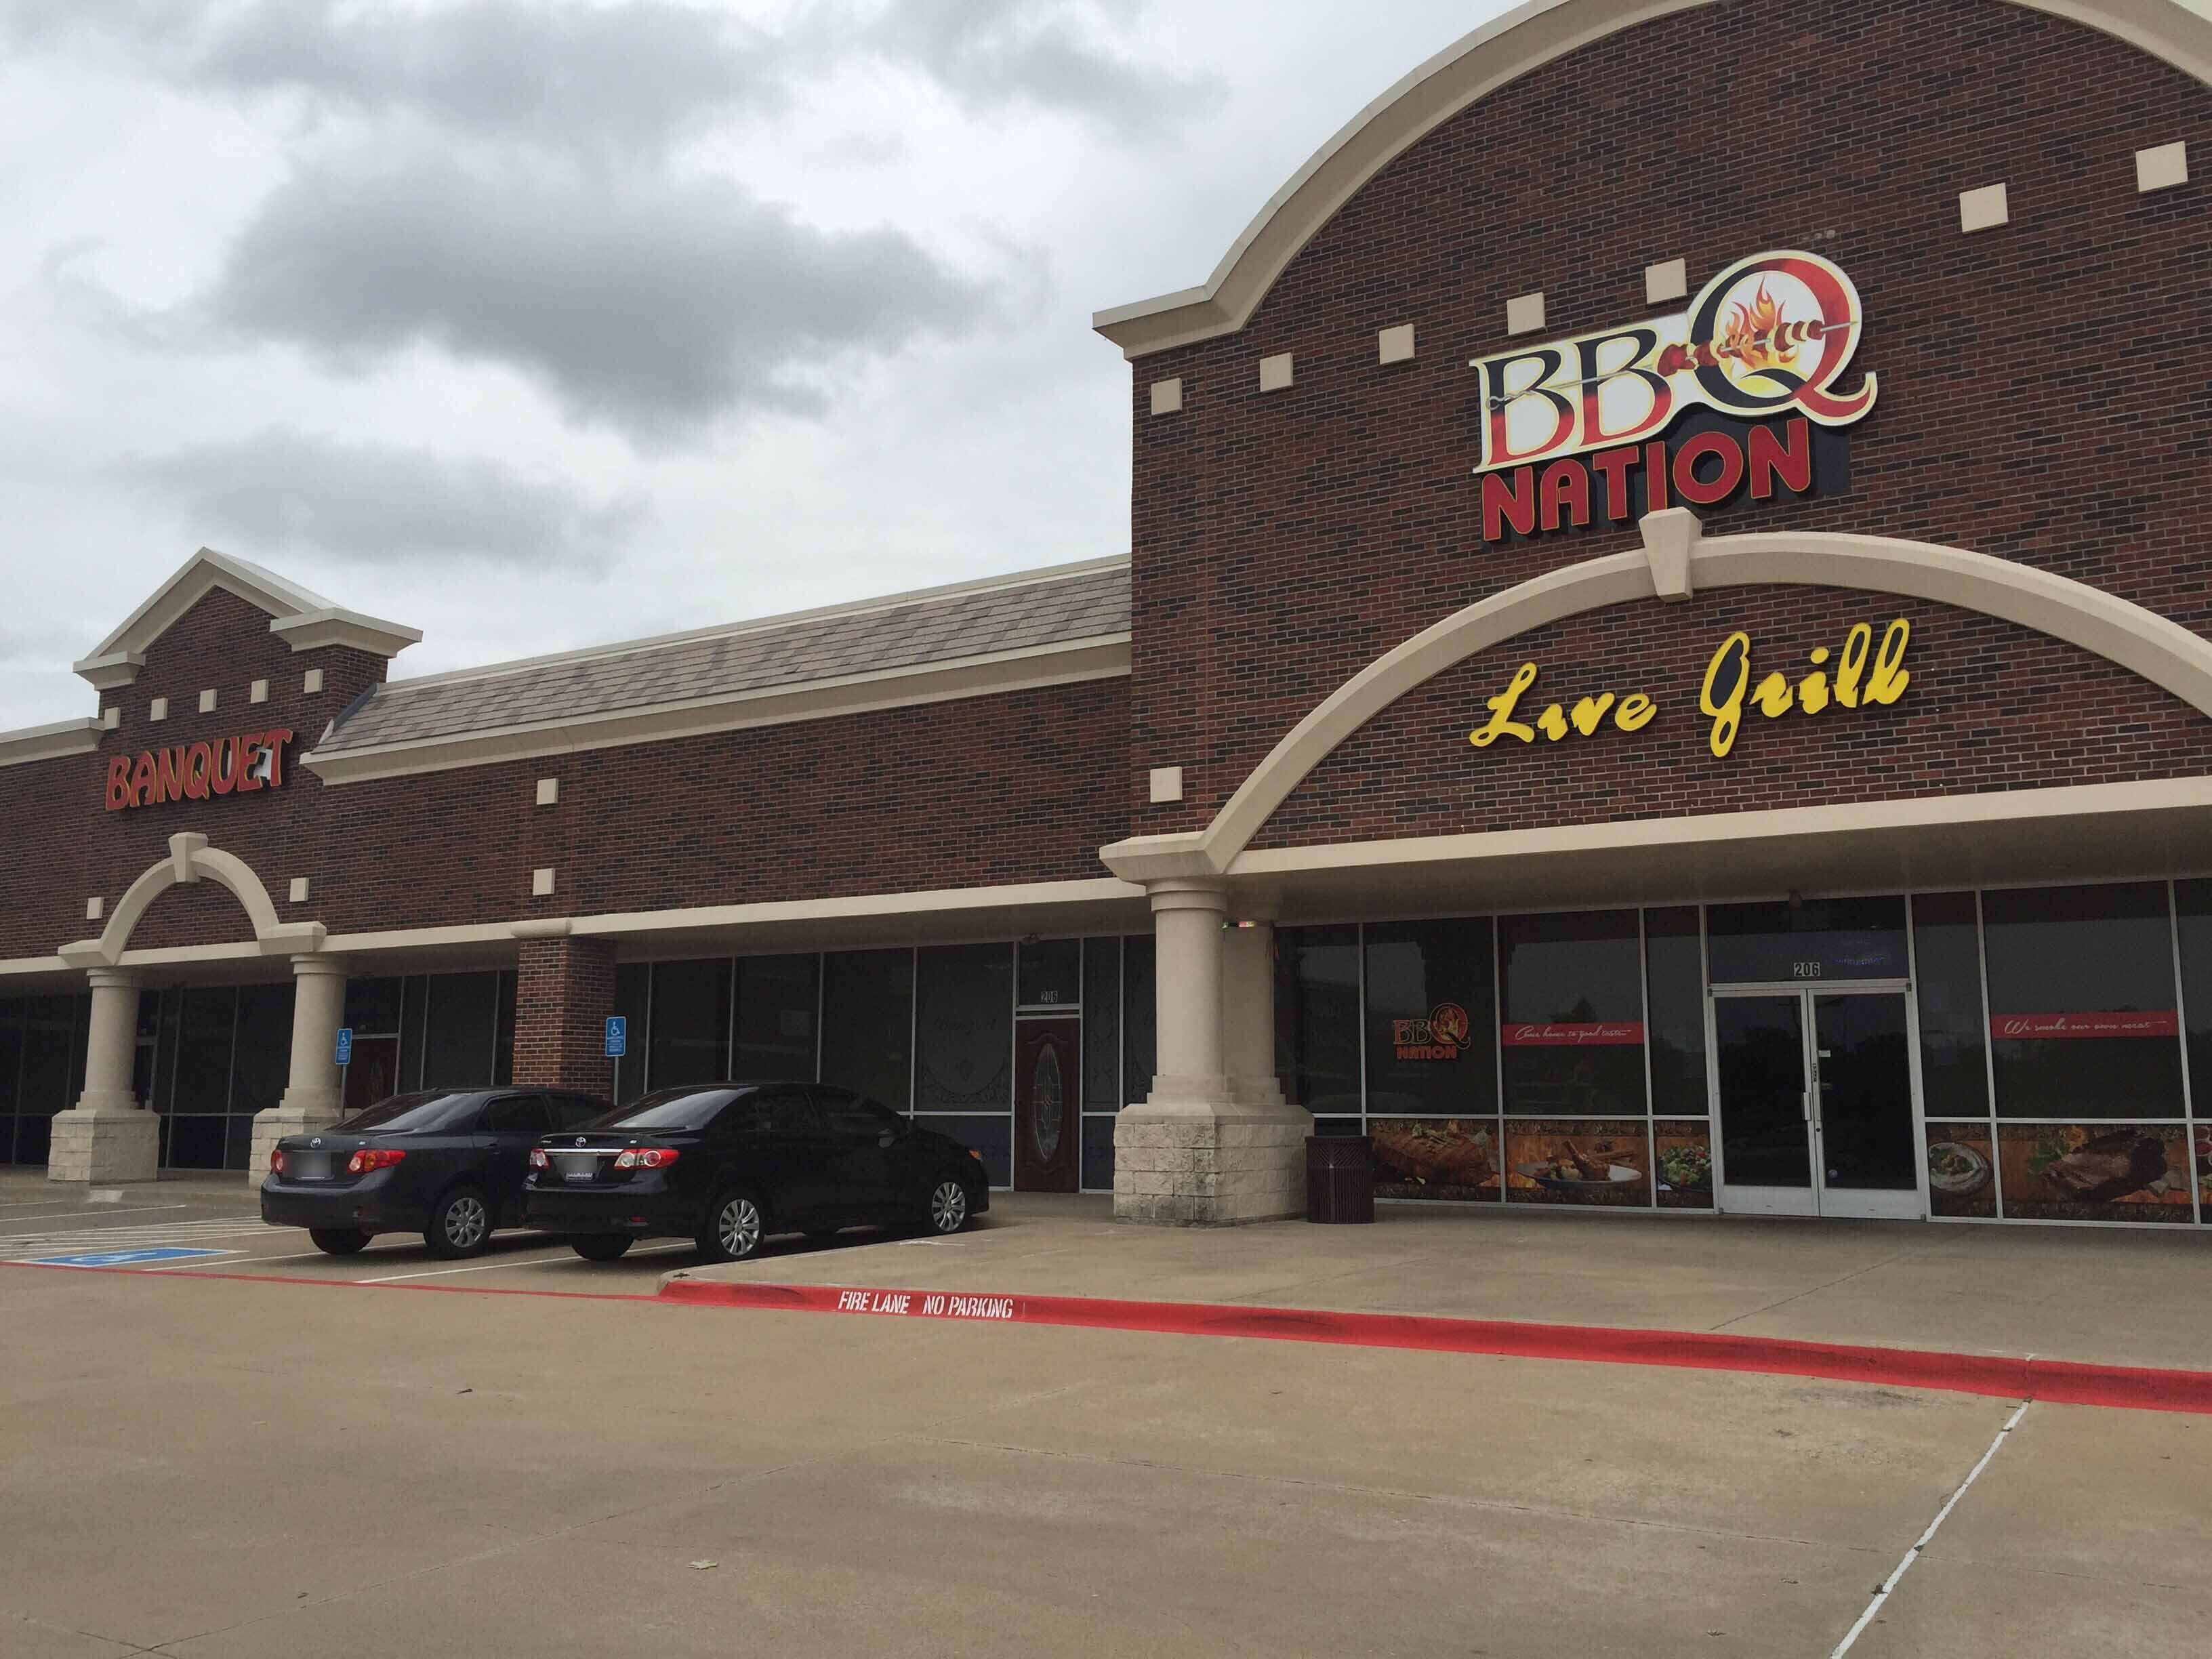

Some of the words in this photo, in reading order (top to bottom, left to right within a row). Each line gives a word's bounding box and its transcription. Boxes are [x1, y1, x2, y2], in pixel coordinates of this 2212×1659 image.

[1472, 251, 1877, 470] BBQ
[1481, 418, 1811, 541] NATION
[1699, 617, 1910, 758] Grill
[106, 729, 293, 811] BANQUET
[1795, 963, 1820, 976] 206
[1393, 1002, 1471, 1050] BBQ
[2004, 1019, 2030, 1035] We
[1396, 1046, 1457, 1060] NATION
[838, 1290, 871, 1311] FIRE
[872, 1292, 911, 1315] LANE
[922, 1295, 945, 1315] NO
[947, 1296, 1013, 1319] PARKING
